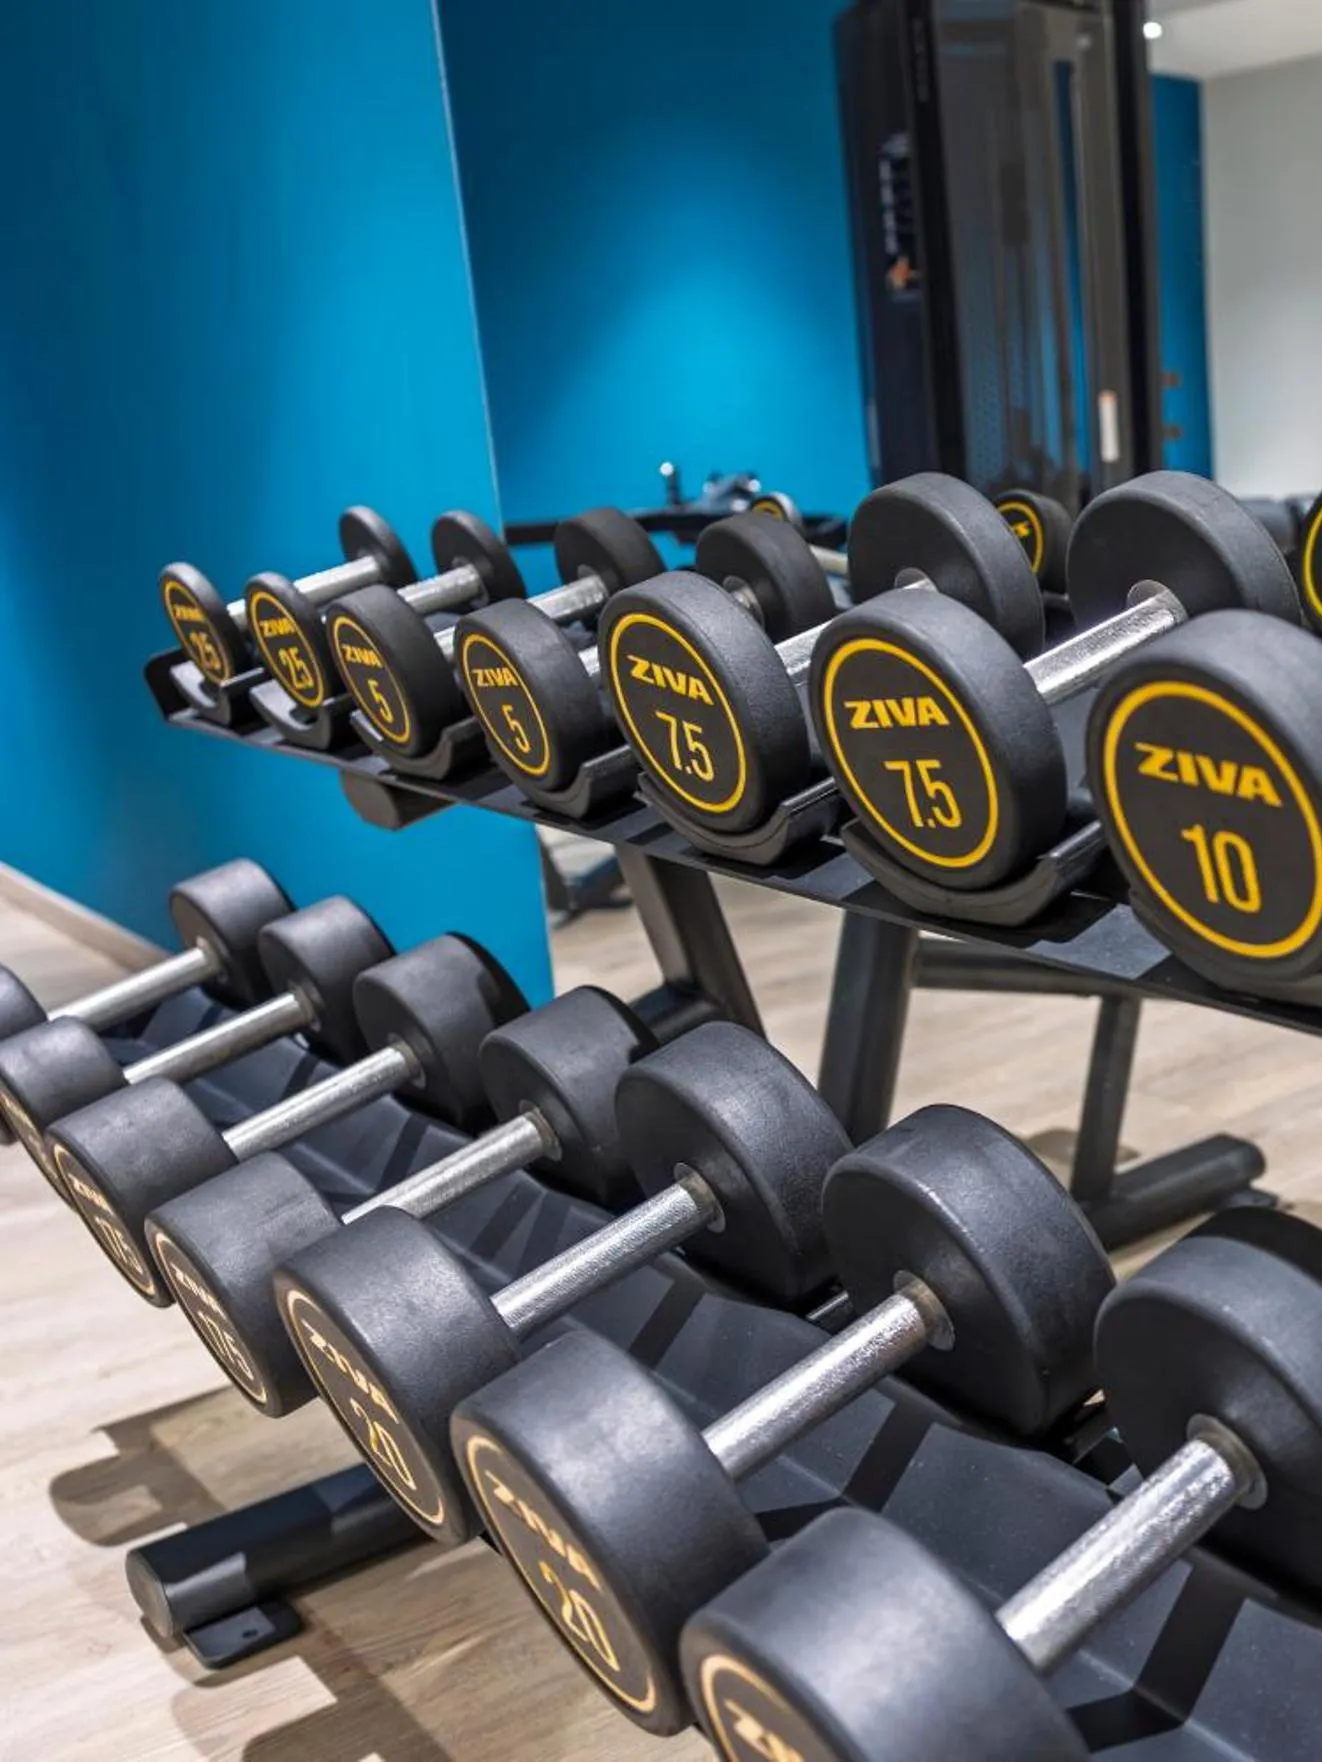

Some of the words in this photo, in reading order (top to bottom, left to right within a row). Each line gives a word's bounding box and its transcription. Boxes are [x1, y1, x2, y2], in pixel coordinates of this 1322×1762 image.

[342, 643, 385, 669] ZIVA
[472, 667, 520, 687] ZIVA
[626, 654, 715, 706] ZIVA
[367, 678, 394, 725] 5
[501, 703, 531, 754] 5
[843, 695, 950, 730] ZIVA
[654, 710, 715, 782] 7.5
[1134, 741, 1283, 808] ZIVA
[883, 758, 962, 829] 7.5
[1181, 823, 1262, 914] 10
[350, 1397, 417, 1491] 20
[538, 1560, 621, 1672] 20
